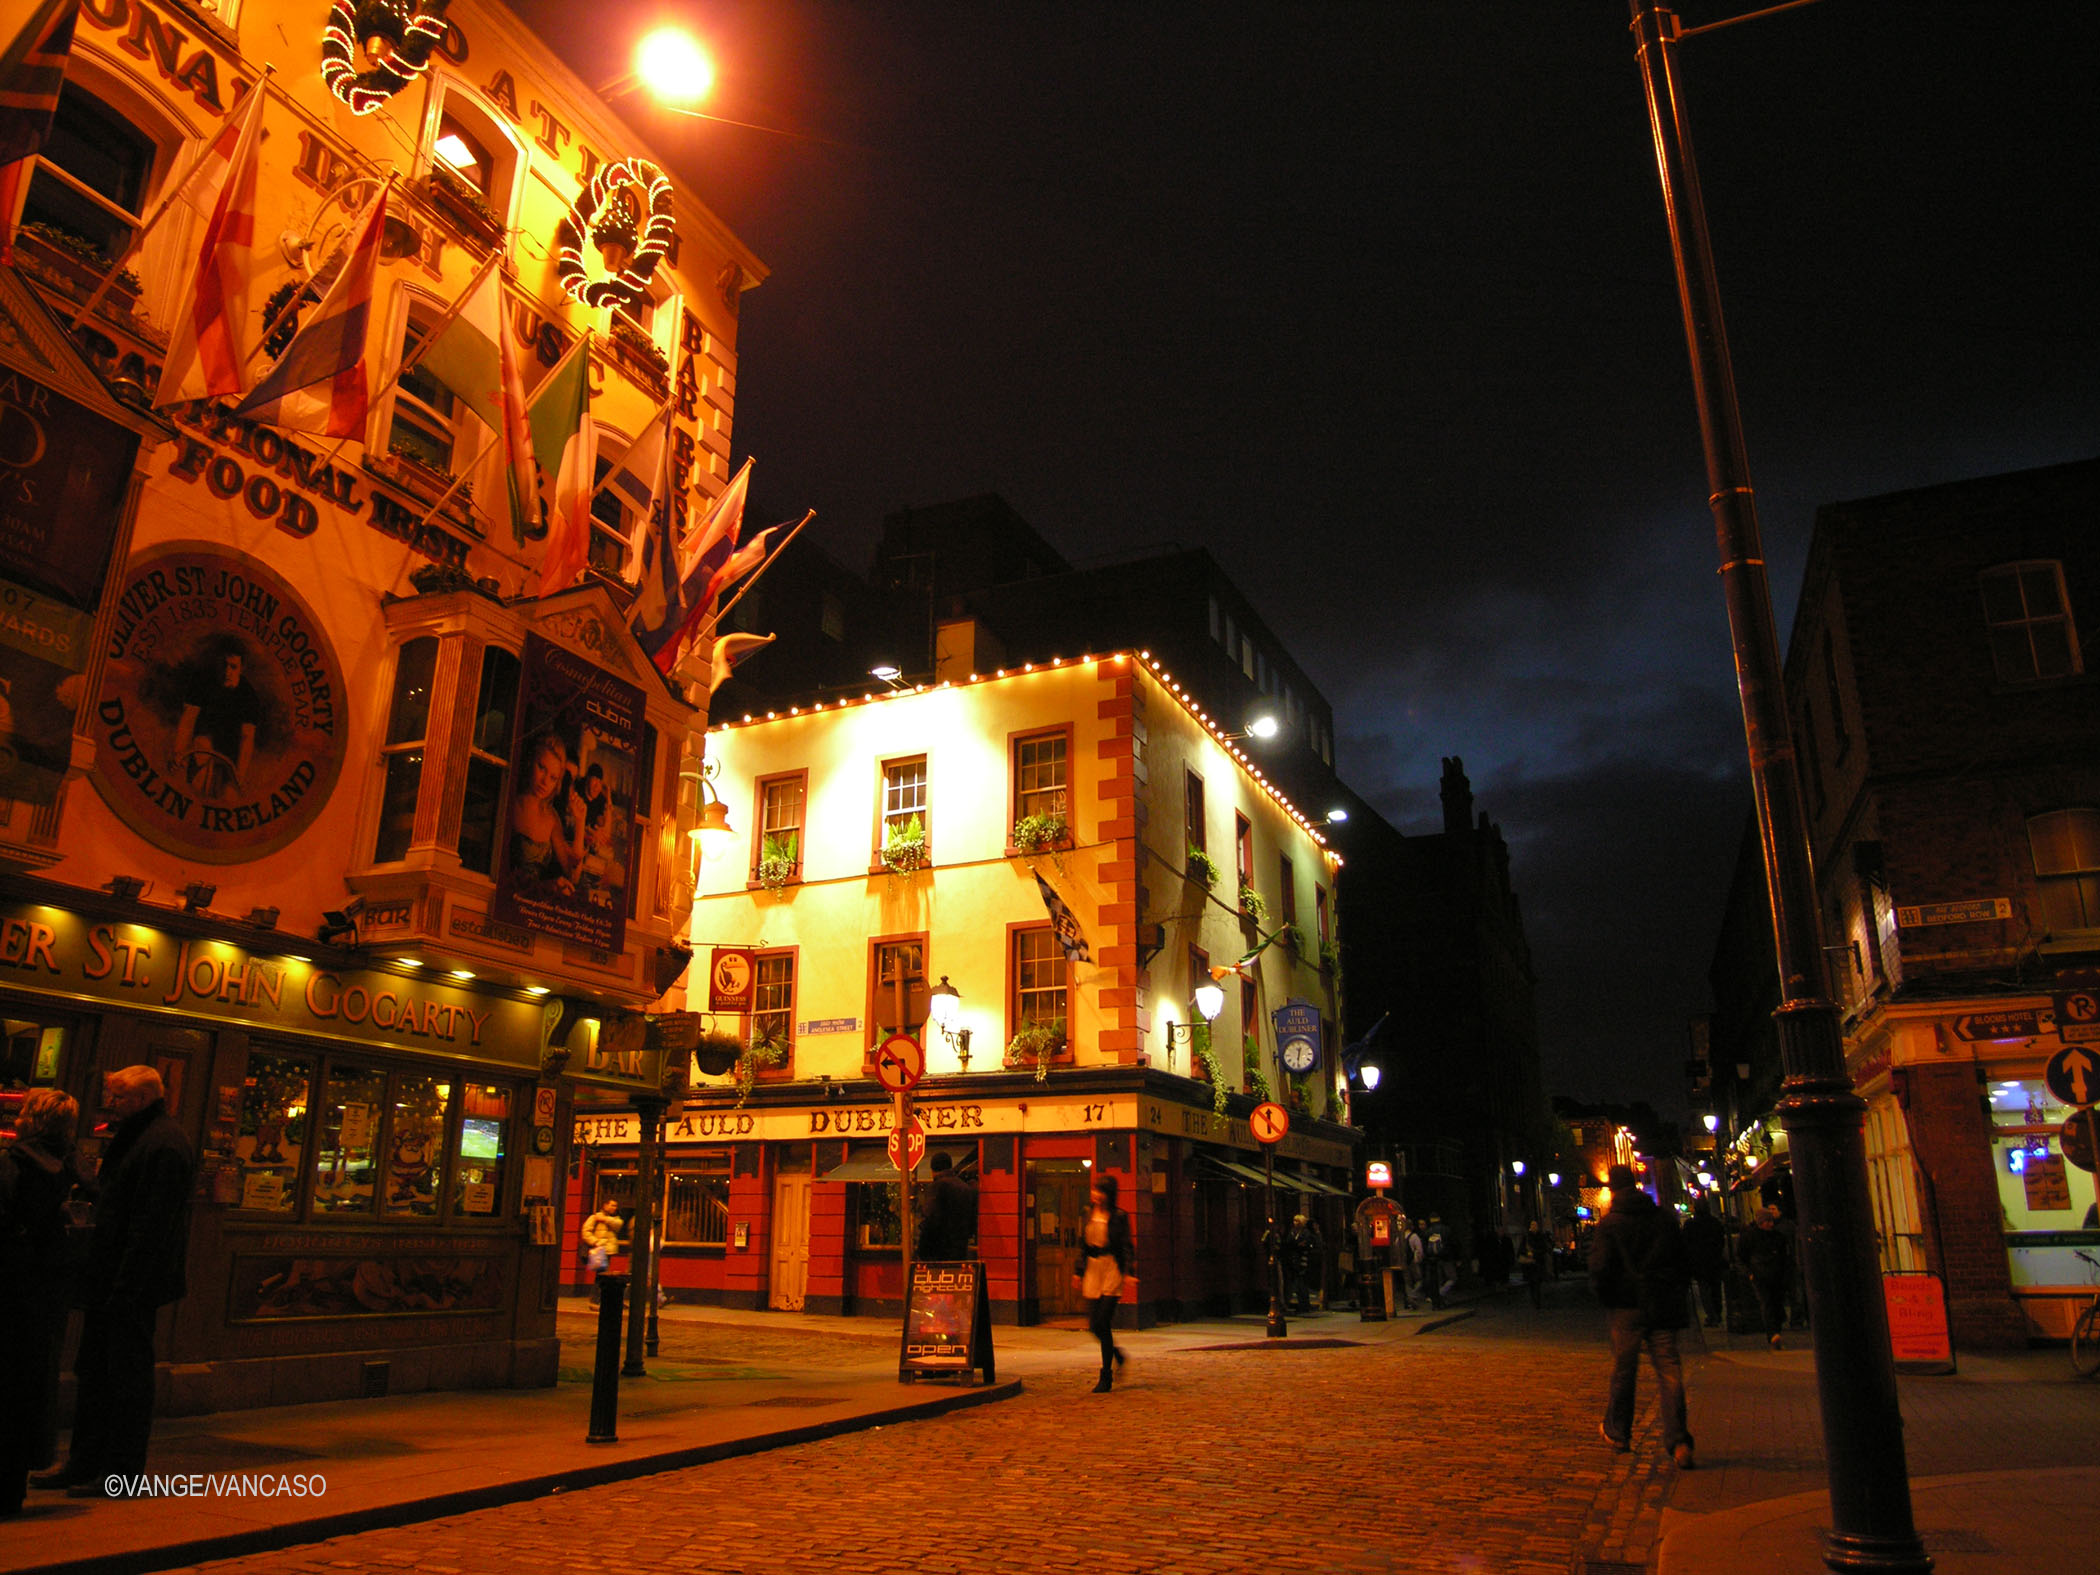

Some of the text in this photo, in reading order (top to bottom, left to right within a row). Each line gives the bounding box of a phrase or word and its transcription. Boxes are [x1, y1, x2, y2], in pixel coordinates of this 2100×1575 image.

[168, 439, 319, 539] FOOD
[213, 570, 279, 620] JOHN
[279, 615, 334, 737] GOGARTY
[225, 602, 299, 675] TEMPLE
[291, 680, 310, 729] BAR
[544, 648, 632, 707] Cosmopolitan
[100, 697, 316, 833] DUBLIN IRELAND
[1926, 913, 1967, 923] BEDFORD
[1969, 910, 1991, 920] ROW
[162, 940, 288, 1012] JOHN
[305, 970, 494, 1046] GOGARTY
[714, 994, 747, 1002] GUINNESS
[1287, 1016, 1309, 1025] AULD
[1290, 1007, 1306, 1017] THE
[1973, 1011, 2035, 1025] BLOOMS HOTEL
[575, 1104, 985, 1139] THE AULD DUBLNER
[1083, 1104, 1105, 1123] 17
[1149, 1105, 1163, 1126] 24
[1182, 1110, 1209, 1137] THE
[891, 1132, 923, 1152] SOP
[912, 1268, 954, 1285] club
[906, 1344, 968, 1357] open
